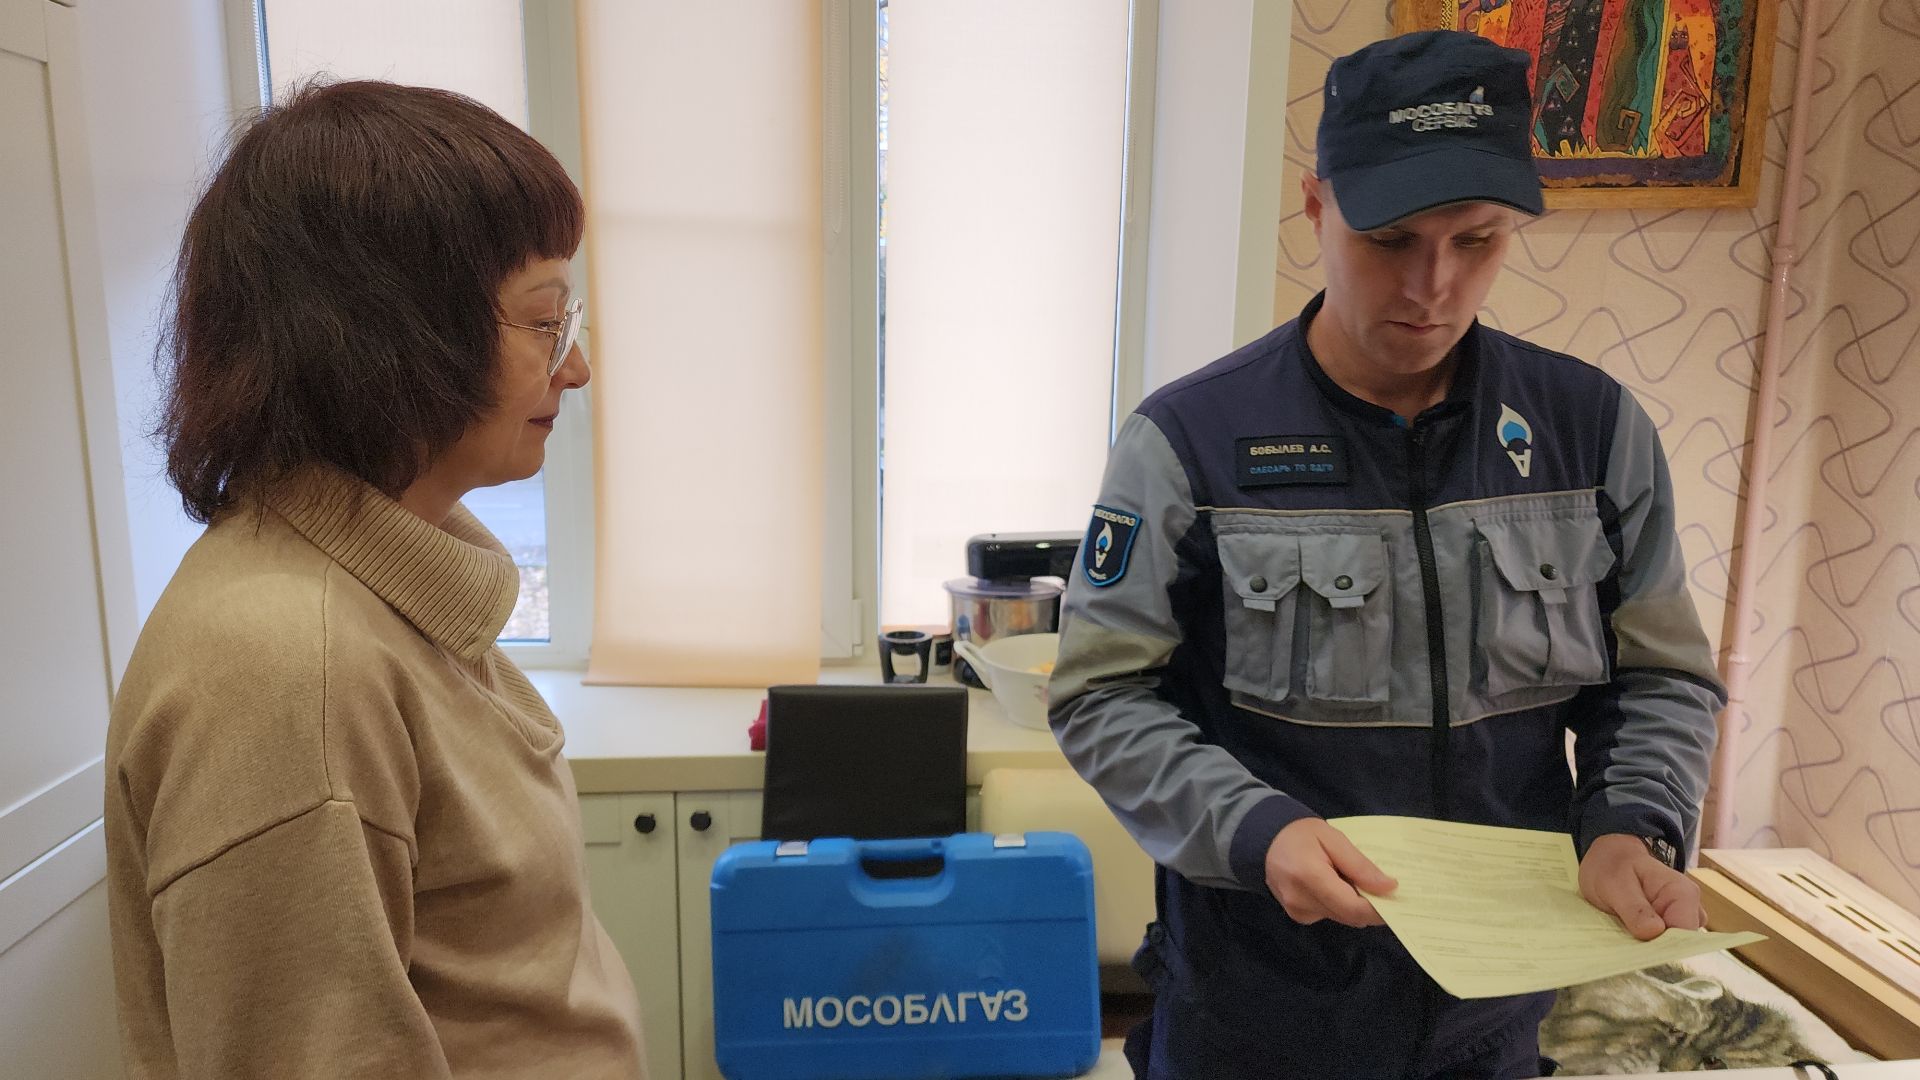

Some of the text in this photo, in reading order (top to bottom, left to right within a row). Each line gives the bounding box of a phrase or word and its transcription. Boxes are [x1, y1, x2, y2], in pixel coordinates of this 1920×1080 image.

[1411, 115, 1478, 132] СЕРВИС
[1250, 444, 1332, 455] БОБЫЛЕВ А.С.
[1250, 464, 1291, 474] СЛЕСАРЬ
[782, 989, 1029, 1029] МОСОБЛГАЗ
